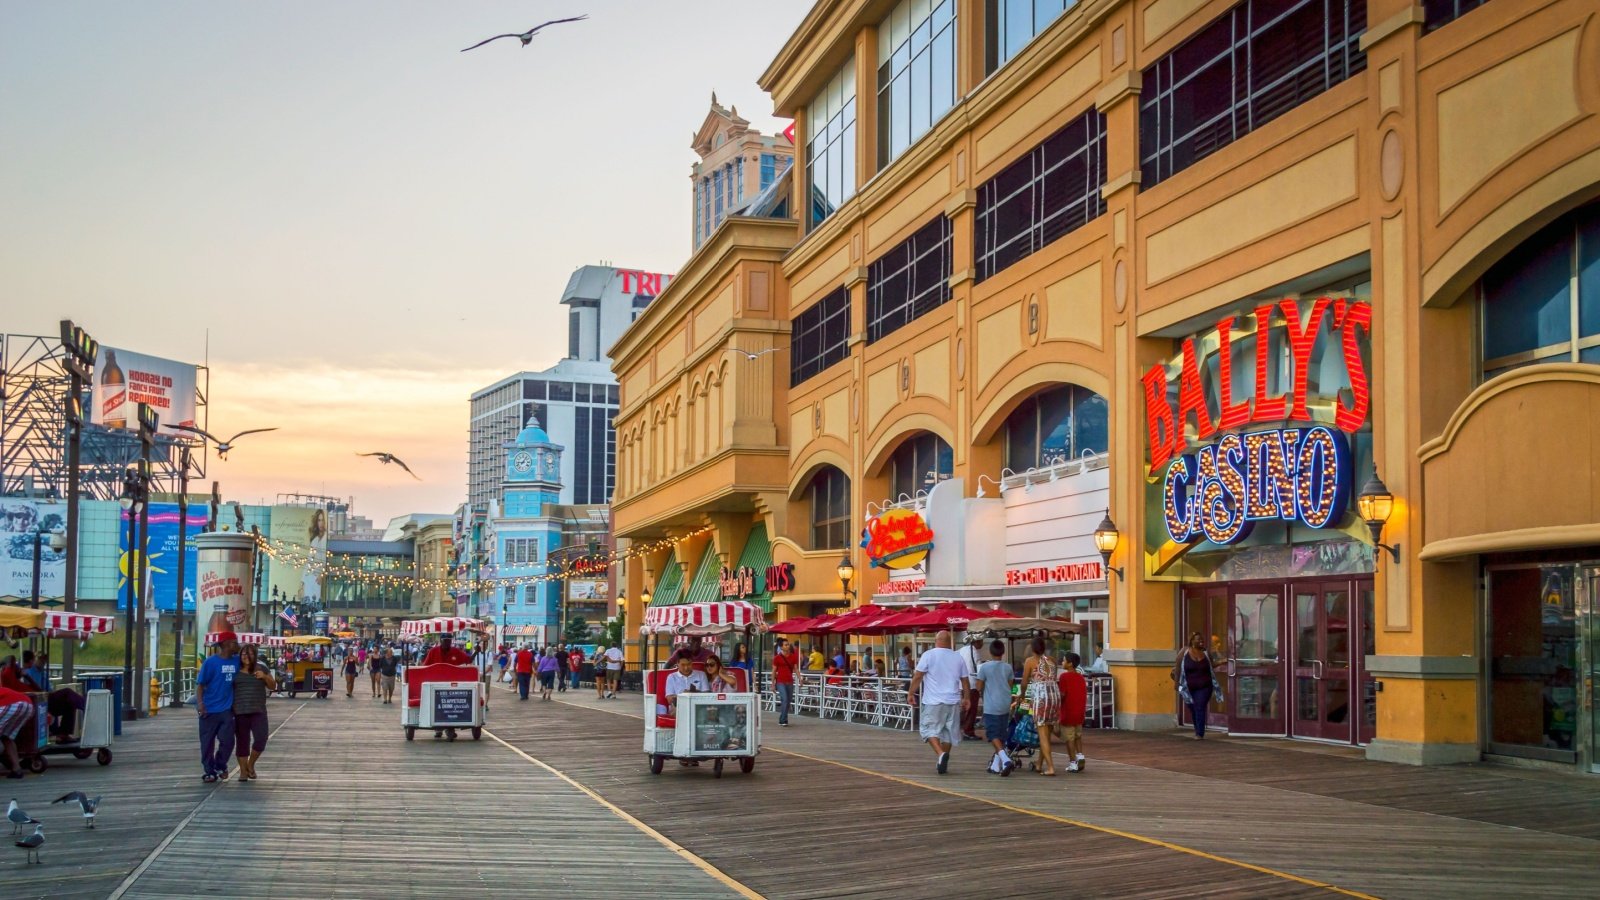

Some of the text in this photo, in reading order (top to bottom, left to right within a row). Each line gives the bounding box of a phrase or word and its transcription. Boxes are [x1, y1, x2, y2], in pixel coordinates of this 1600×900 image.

[1141, 297, 1372, 476] BALLY'S
[1164, 427, 1340, 544] CASINO
[201, 577, 239, 592] COME IN
[1006, 562, 1100, 586] PIE CHILI FOUNTAIN
